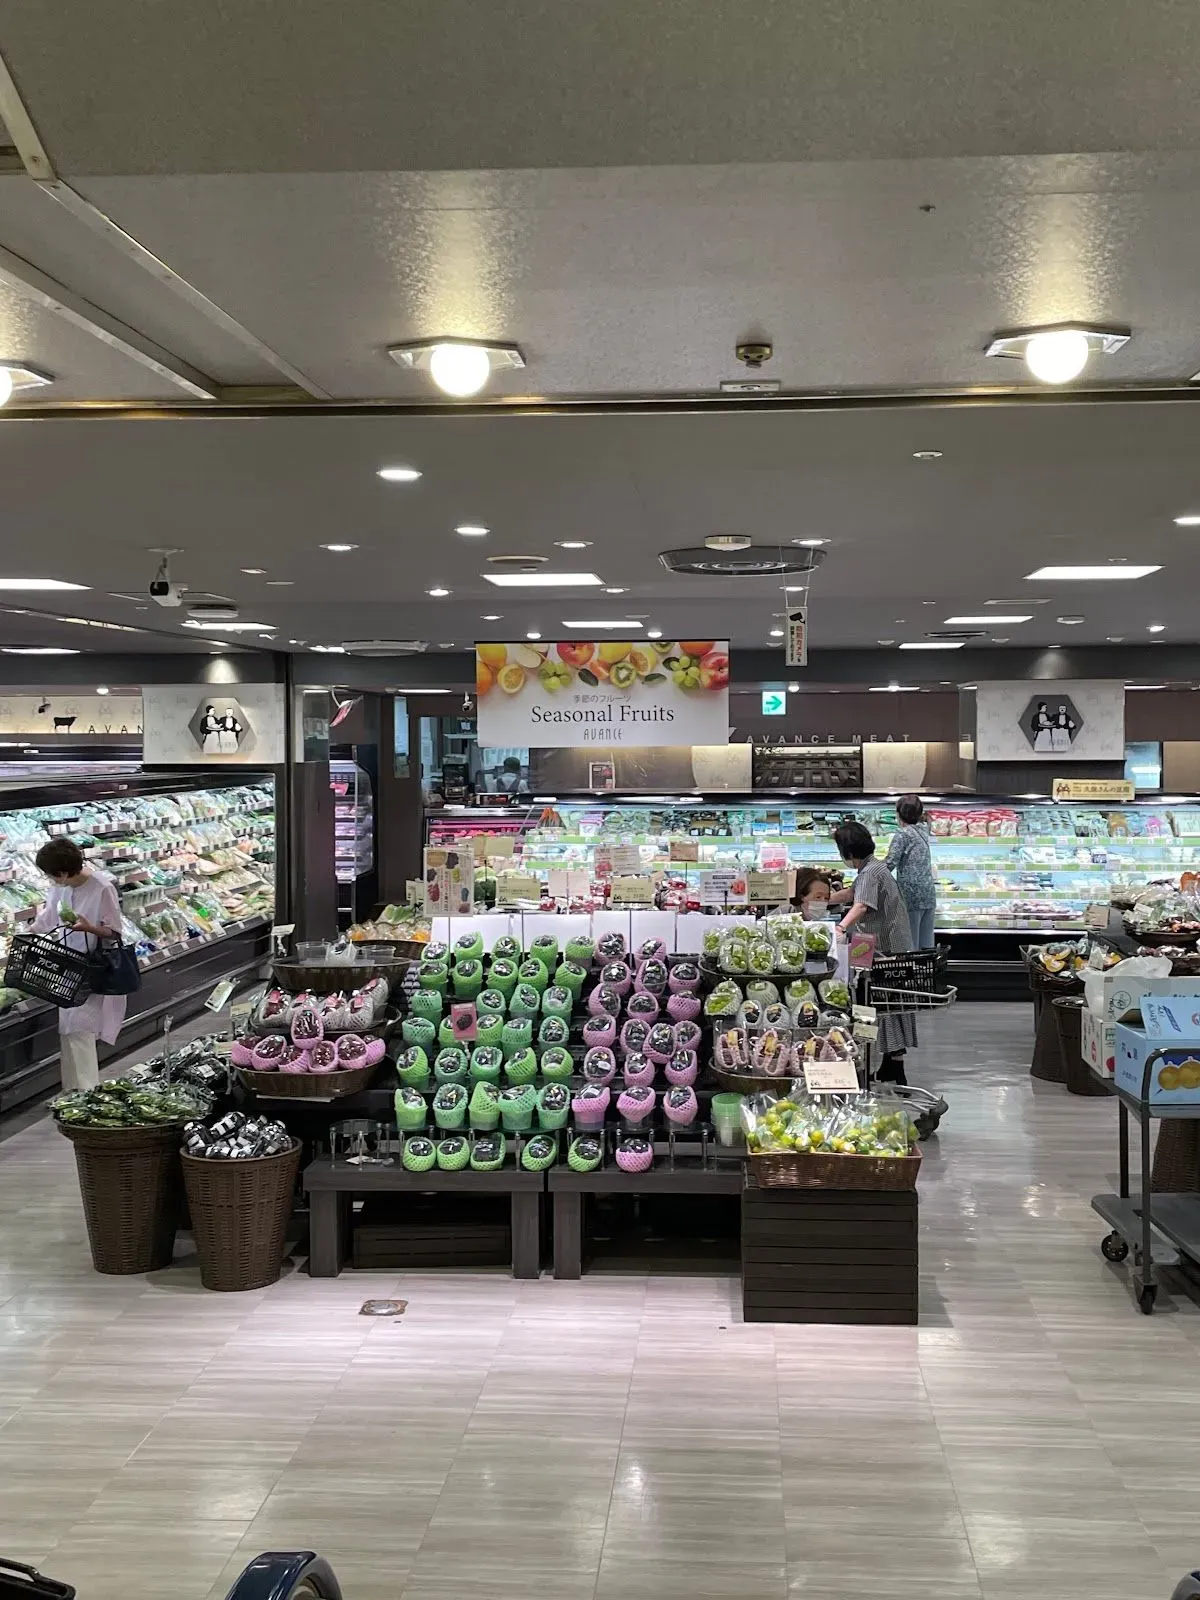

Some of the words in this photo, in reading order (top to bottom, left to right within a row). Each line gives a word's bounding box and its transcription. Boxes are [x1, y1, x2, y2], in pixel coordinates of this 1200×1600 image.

[573, 694, 632, 704] 季節のフルーツ
[531, 704, 612, 723] Seasonal
[619, 704, 675, 722] Fruits
[88, 724, 144, 735] AVAN
[583, 728, 622, 741] AVANCE
[746, 734, 836, 744] AVANCE
[852, 733, 910, 744] MEAT
